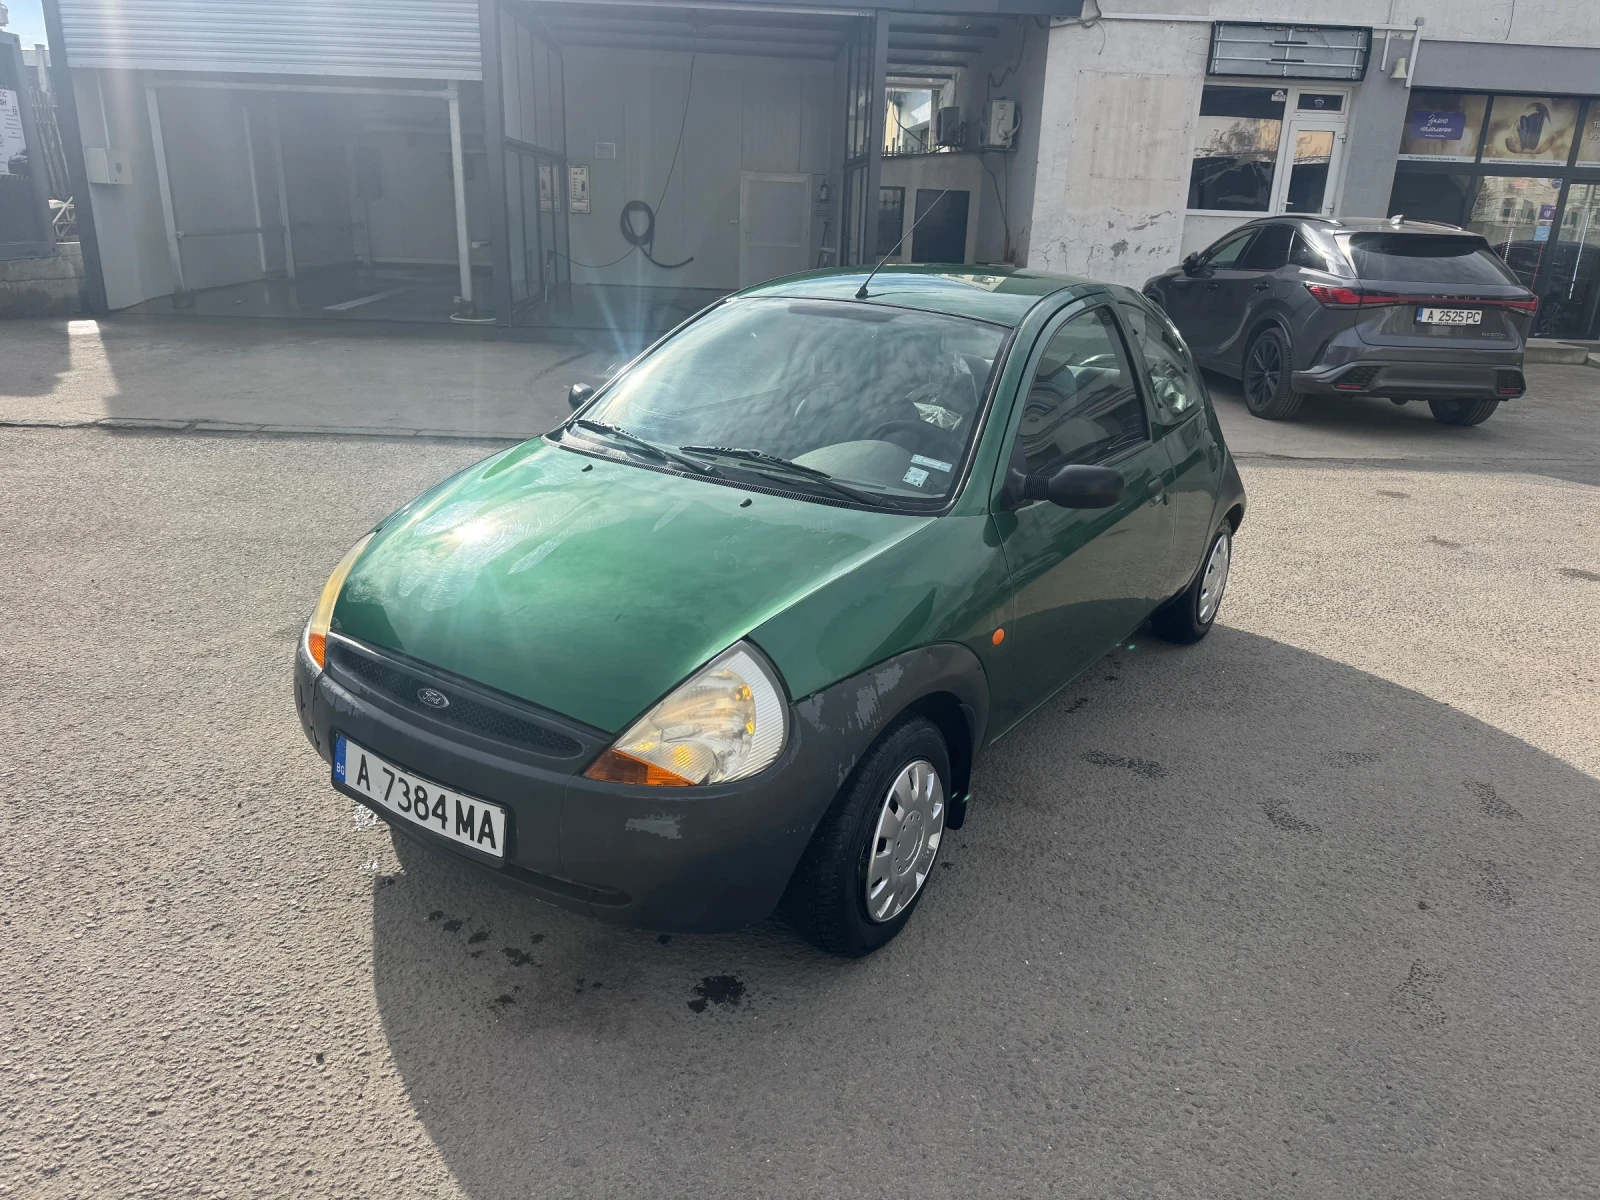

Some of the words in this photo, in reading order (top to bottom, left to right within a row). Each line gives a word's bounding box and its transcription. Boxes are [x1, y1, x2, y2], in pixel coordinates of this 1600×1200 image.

[1427, 310, 1434, 321] A
[1439, 310, 1465, 322] 2525
[1465, 312, 1480, 323] PC
[336, 762, 345, 776] BG
[356, 754, 371, 791] A
[382, 767, 448, 830] 7384
[455, 800, 497, 850] MA
